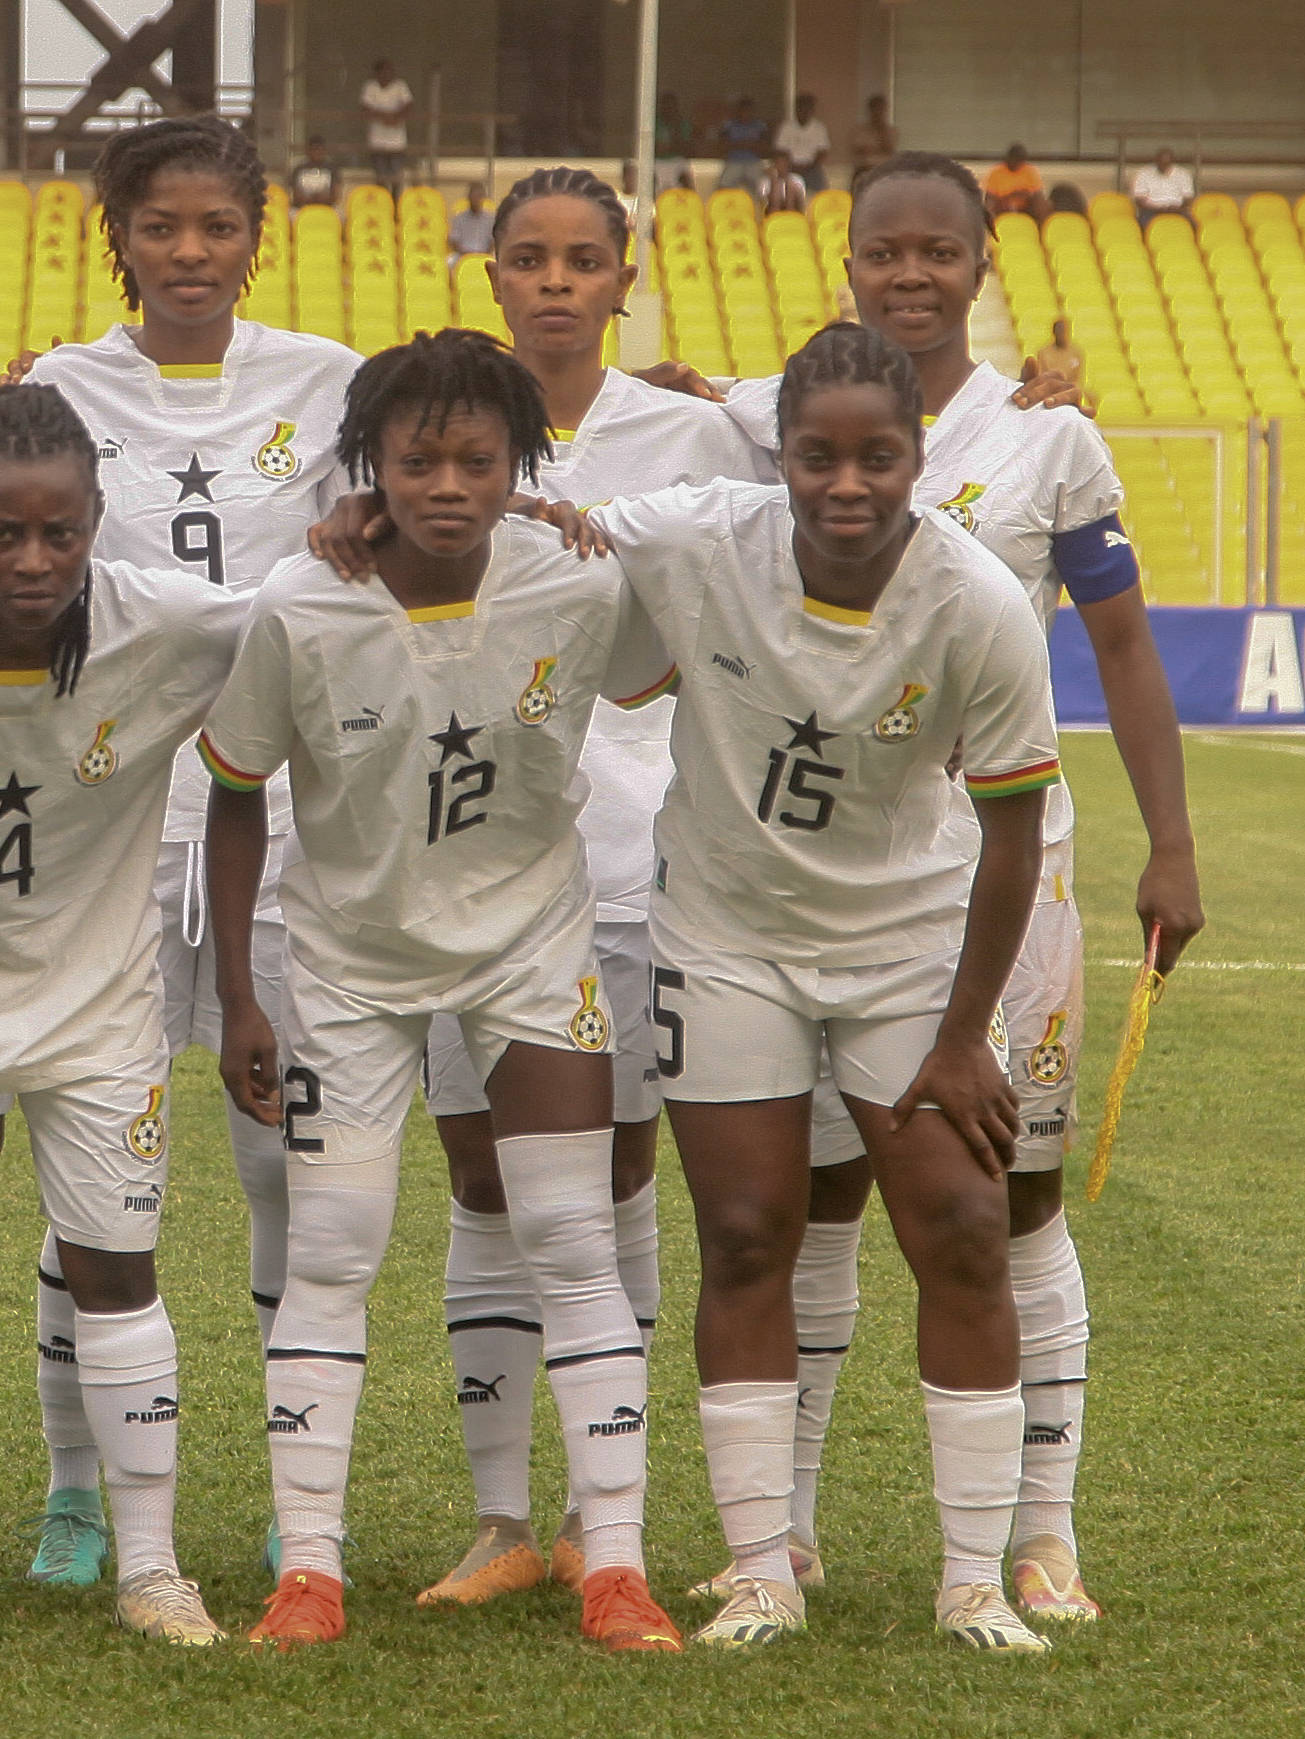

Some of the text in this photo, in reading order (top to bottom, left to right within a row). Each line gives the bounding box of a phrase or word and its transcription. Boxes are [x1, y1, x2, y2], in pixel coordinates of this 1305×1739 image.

[171, 511, 225, 586] 9
[712, 653, 745, 680] PUMA
[342, 718, 378, 731] PUMA
[427, 760, 497, 847] 12
[758, 747, 845, 831] 15
[588, 1420, 640, 1438] PUMA
